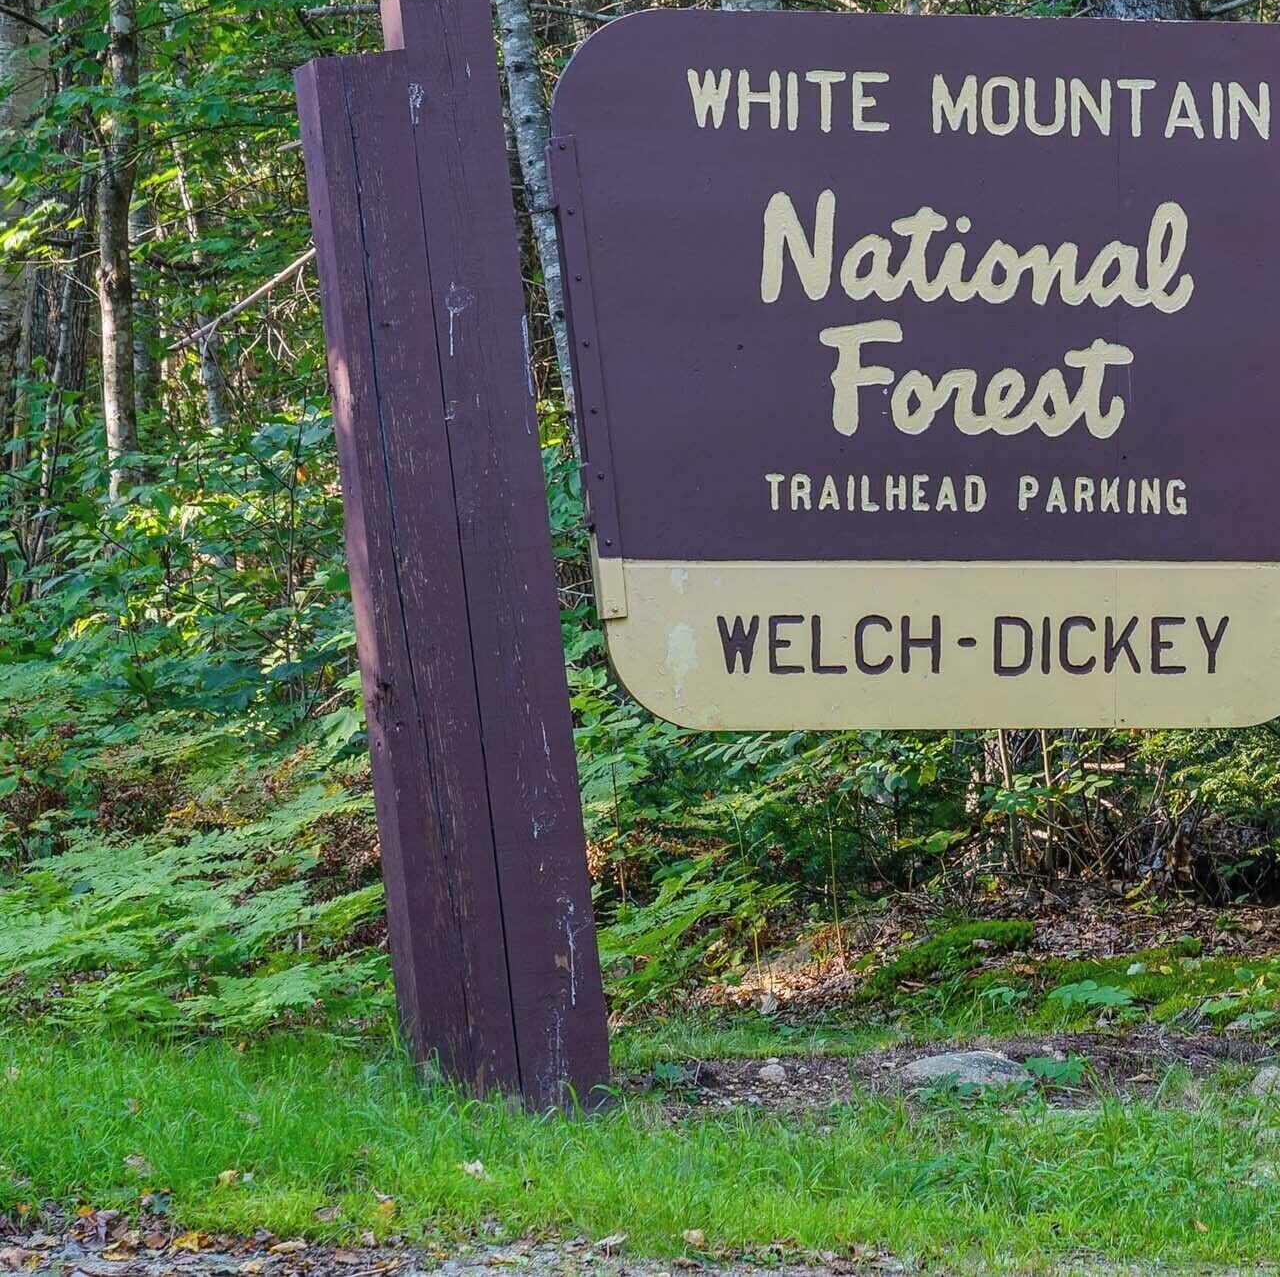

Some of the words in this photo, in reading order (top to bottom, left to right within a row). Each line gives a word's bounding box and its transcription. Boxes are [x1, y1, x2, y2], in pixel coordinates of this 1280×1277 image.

[687, 67, 891, 134] WHITE
[931, 74, 1272, 140] MOUNTAIN
[760, 188, 1195, 314] National
[819, 318, 1135, 439] Forest
[766, 474, 986, 512] TRAILHEAD
[1017, 475, 1189, 516] PARKING
[716, 613, 1231, 676] WELCH-DICKEY
